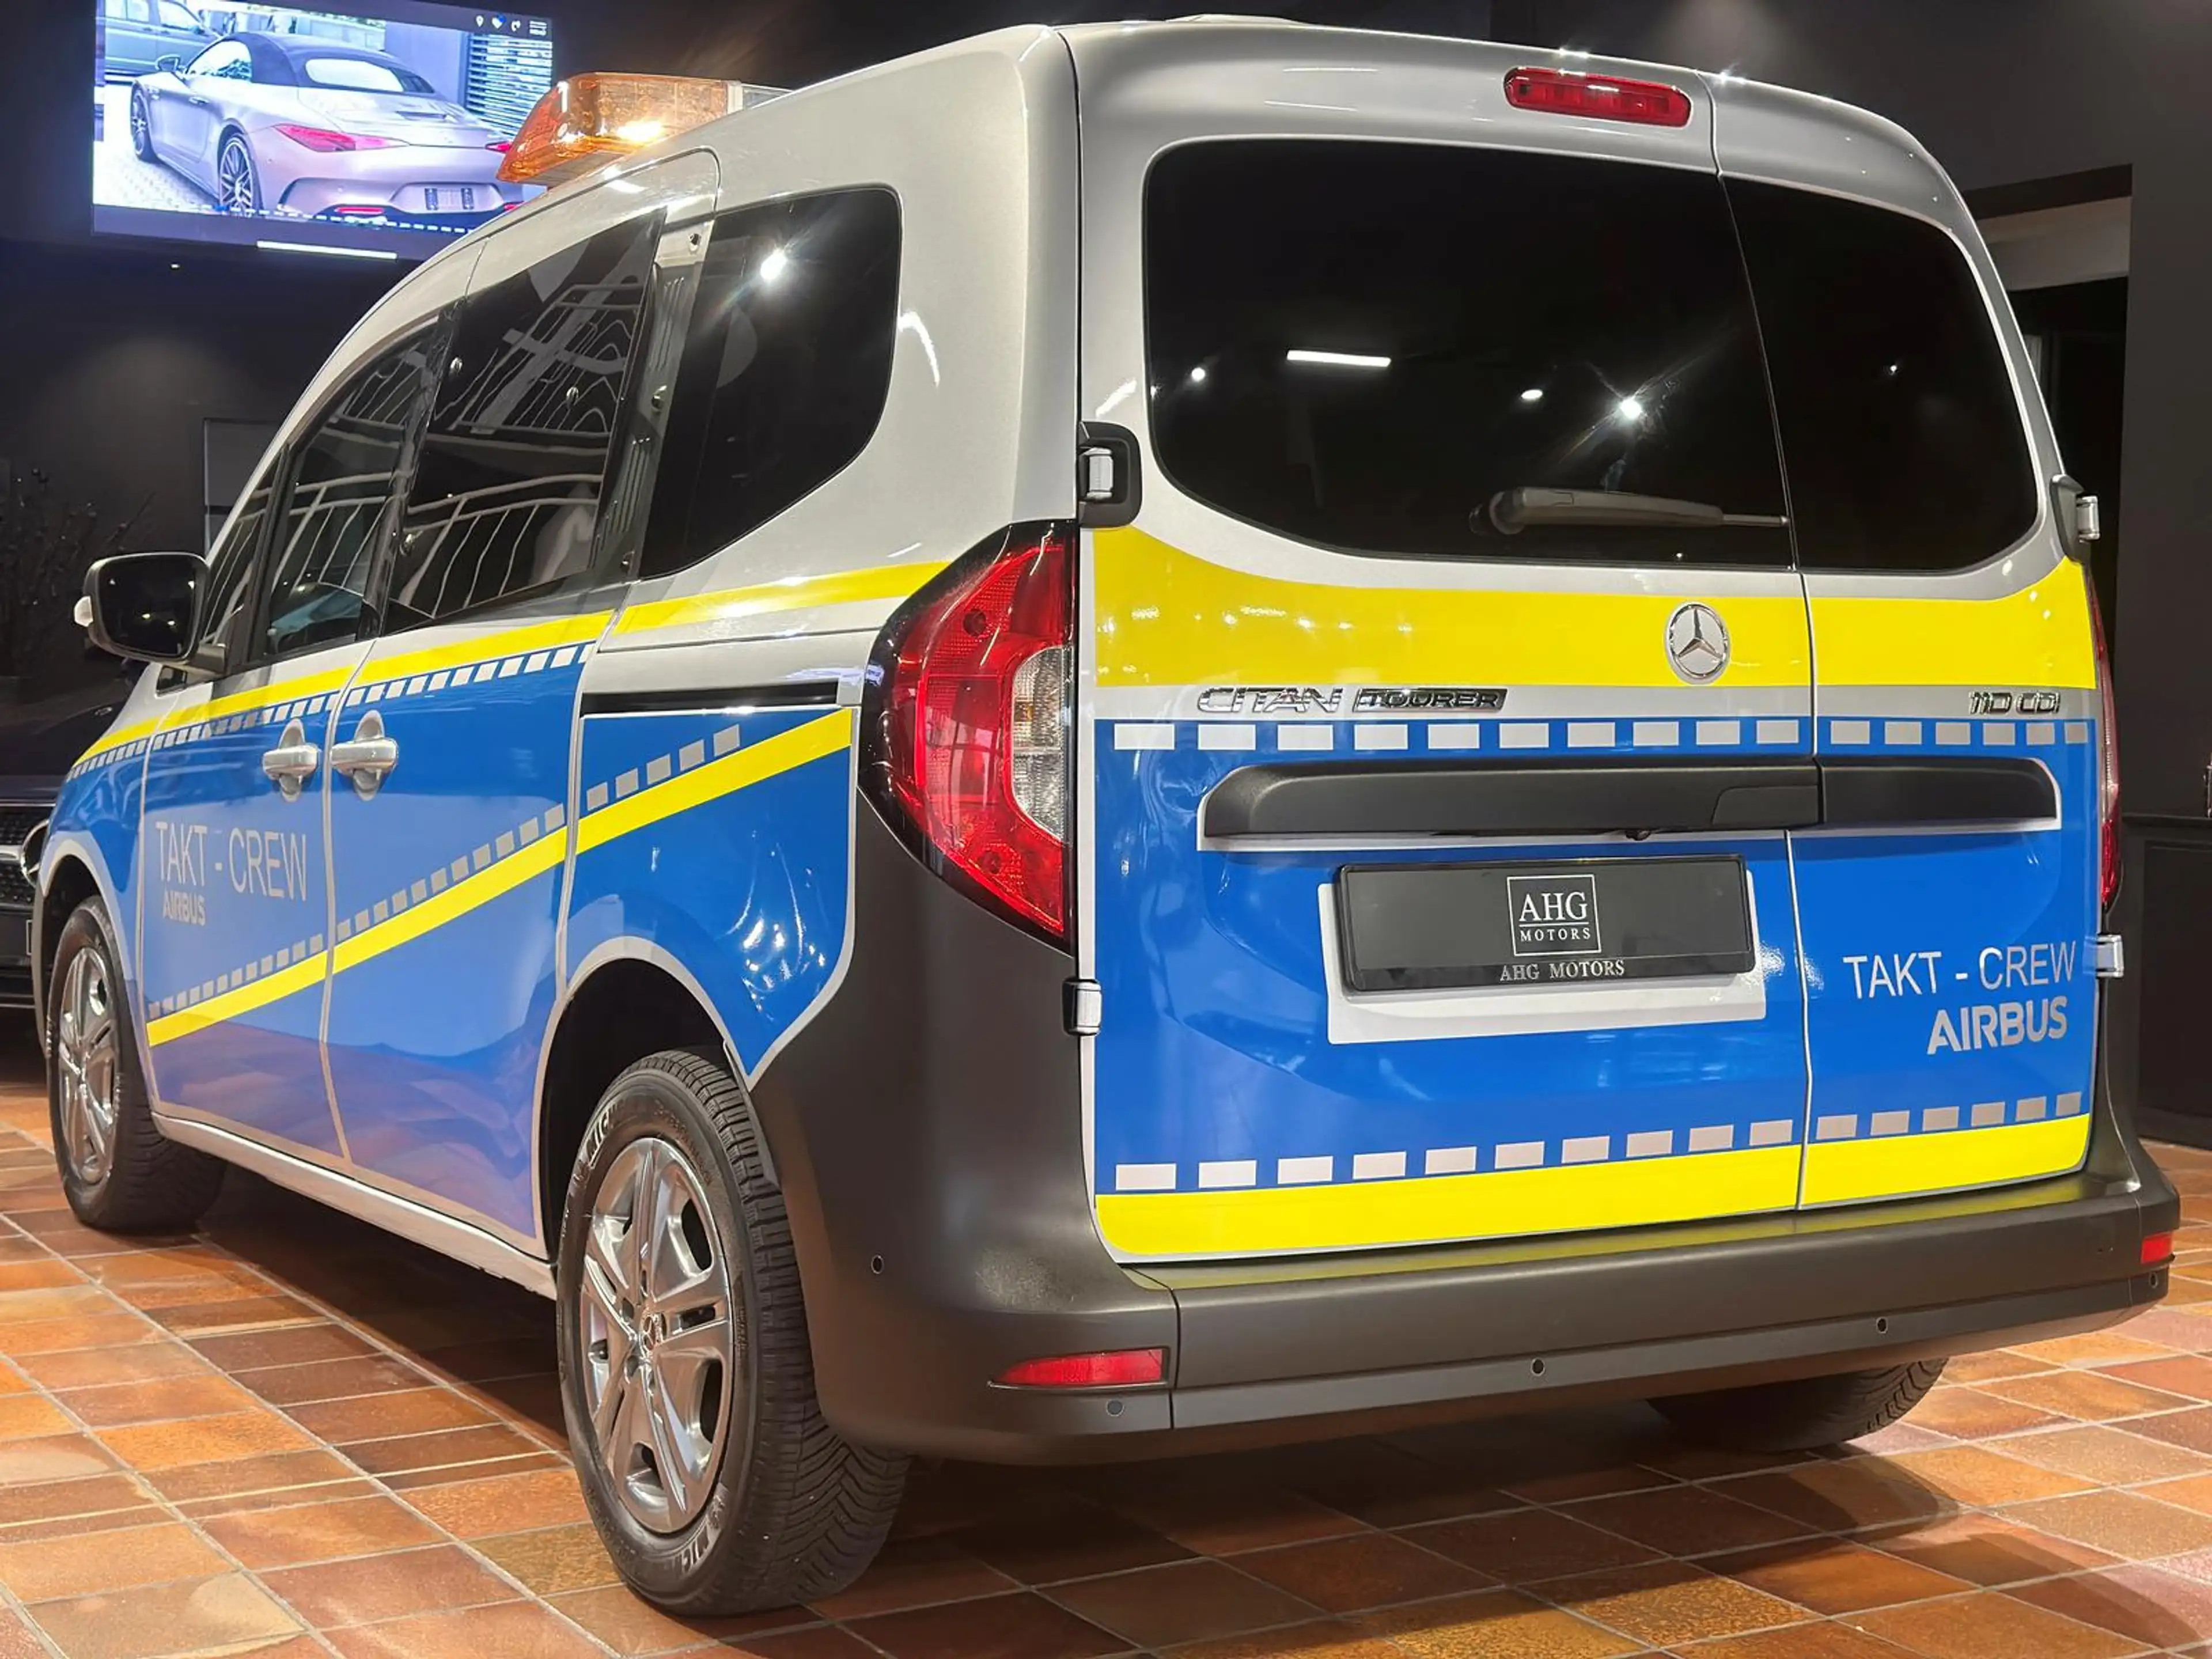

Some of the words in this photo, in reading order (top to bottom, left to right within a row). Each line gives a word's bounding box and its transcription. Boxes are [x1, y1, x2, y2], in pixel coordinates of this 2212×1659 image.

[1197, 686, 1344, 713] CITAN
[1361, 687, 1501, 710] TOURER
[155, 821, 208, 887] TAKT
[229, 827, 308, 902] CREW
[162, 889, 206, 926] AIRBUS
[1518, 891, 1588, 922] AHG
[1520, 927, 1591, 943] MOTORS
[1499, 964, 1540, 982] AHG
[1550, 959, 1626, 980] MOTORS
[1842, 950, 1942, 999] TAKT
[1978, 940, 2077, 990] CREW
[1926, 995, 2069, 1055] AIRBUS
